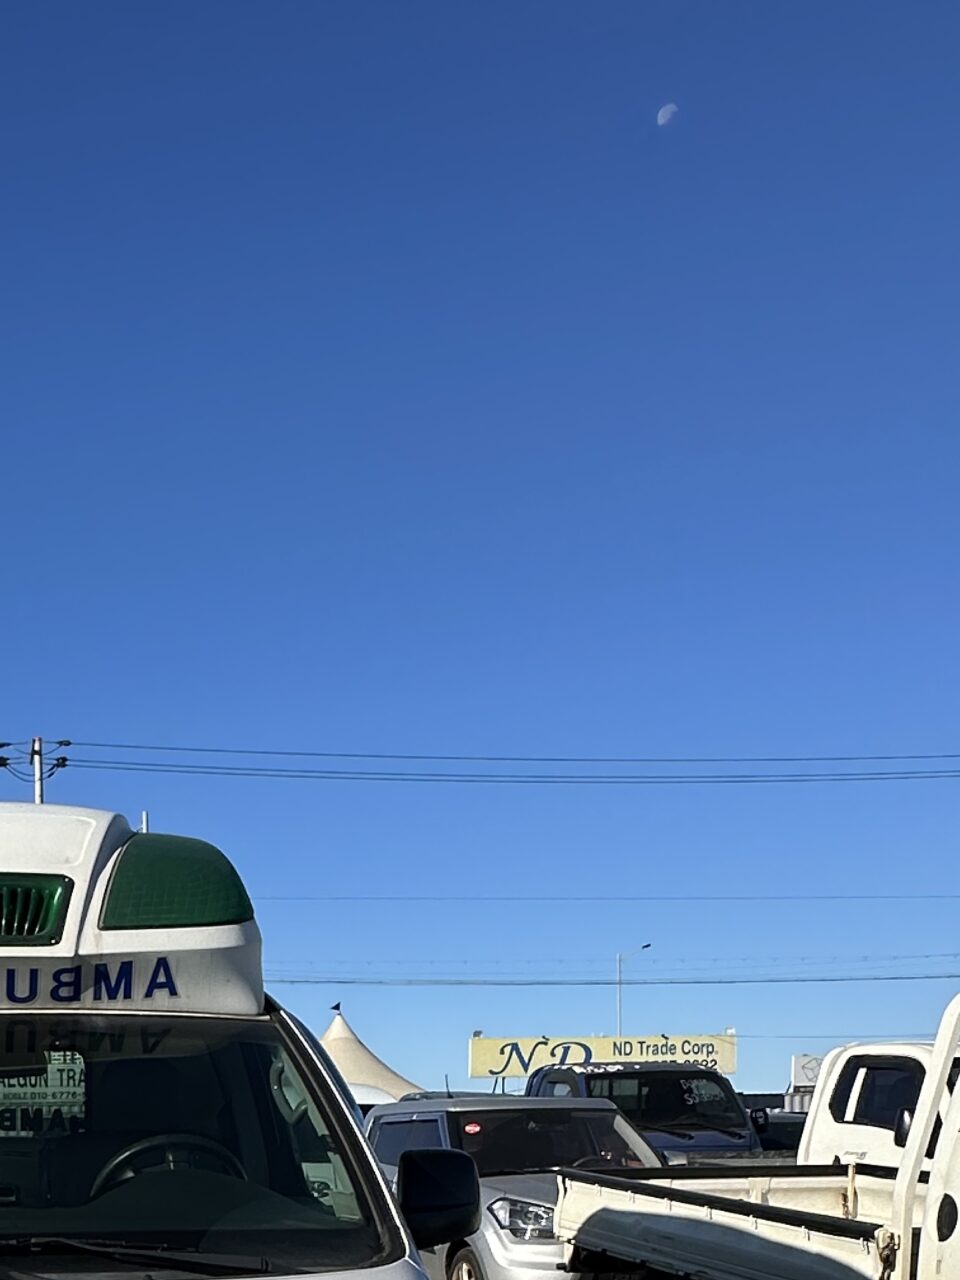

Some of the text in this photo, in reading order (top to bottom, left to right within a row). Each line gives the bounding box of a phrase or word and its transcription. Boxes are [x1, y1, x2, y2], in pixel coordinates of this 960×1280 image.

[488, 1041, 593, 1075] ND
[612, 1041, 633, 1057] ND
[636, 1040, 677, 1056] Trade
